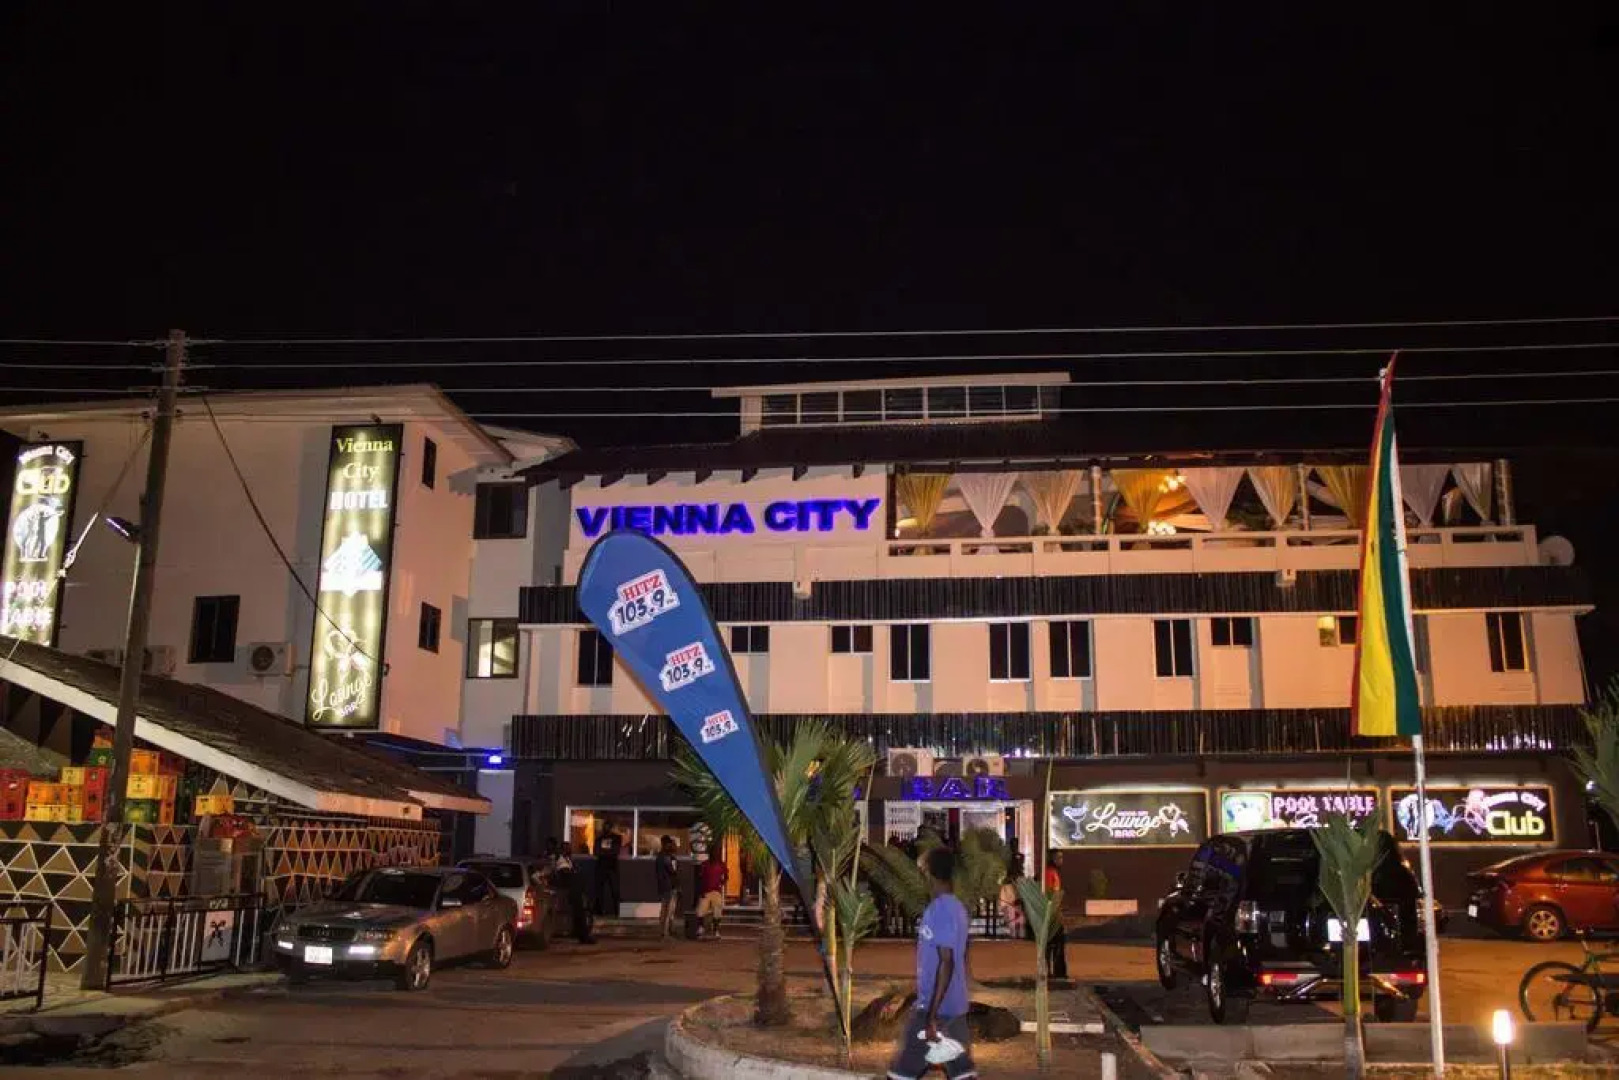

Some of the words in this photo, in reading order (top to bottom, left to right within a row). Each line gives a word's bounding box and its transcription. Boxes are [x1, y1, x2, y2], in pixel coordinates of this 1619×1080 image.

[336, 437, 393, 453] Vienna
[343, 463, 380, 482] City
[330, 489, 387, 510] HOTEL
[576, 502, 756, 537] VIENNA
[764, 498, 880, 532] CITY
[622, 574, 664, 602] HITZ
[617, 589, 665, 625] 103.9
[670, 645, 703, 666] HITZ
[666, 657, 704, 684] 103.9
[312, 670, 371, 721] Lounge
[704, 720, 731, 737] 103.9
[707, 712, 730, 726] HITZ
[906, 776, 1008, 801] BAR
[1274, 796, 1319, 813] POOL
[1322, 796, 1375, 815] TABLE
[1086, 802, 1161, 838] Lounge
[1486, 811, 1546, 836] Club
